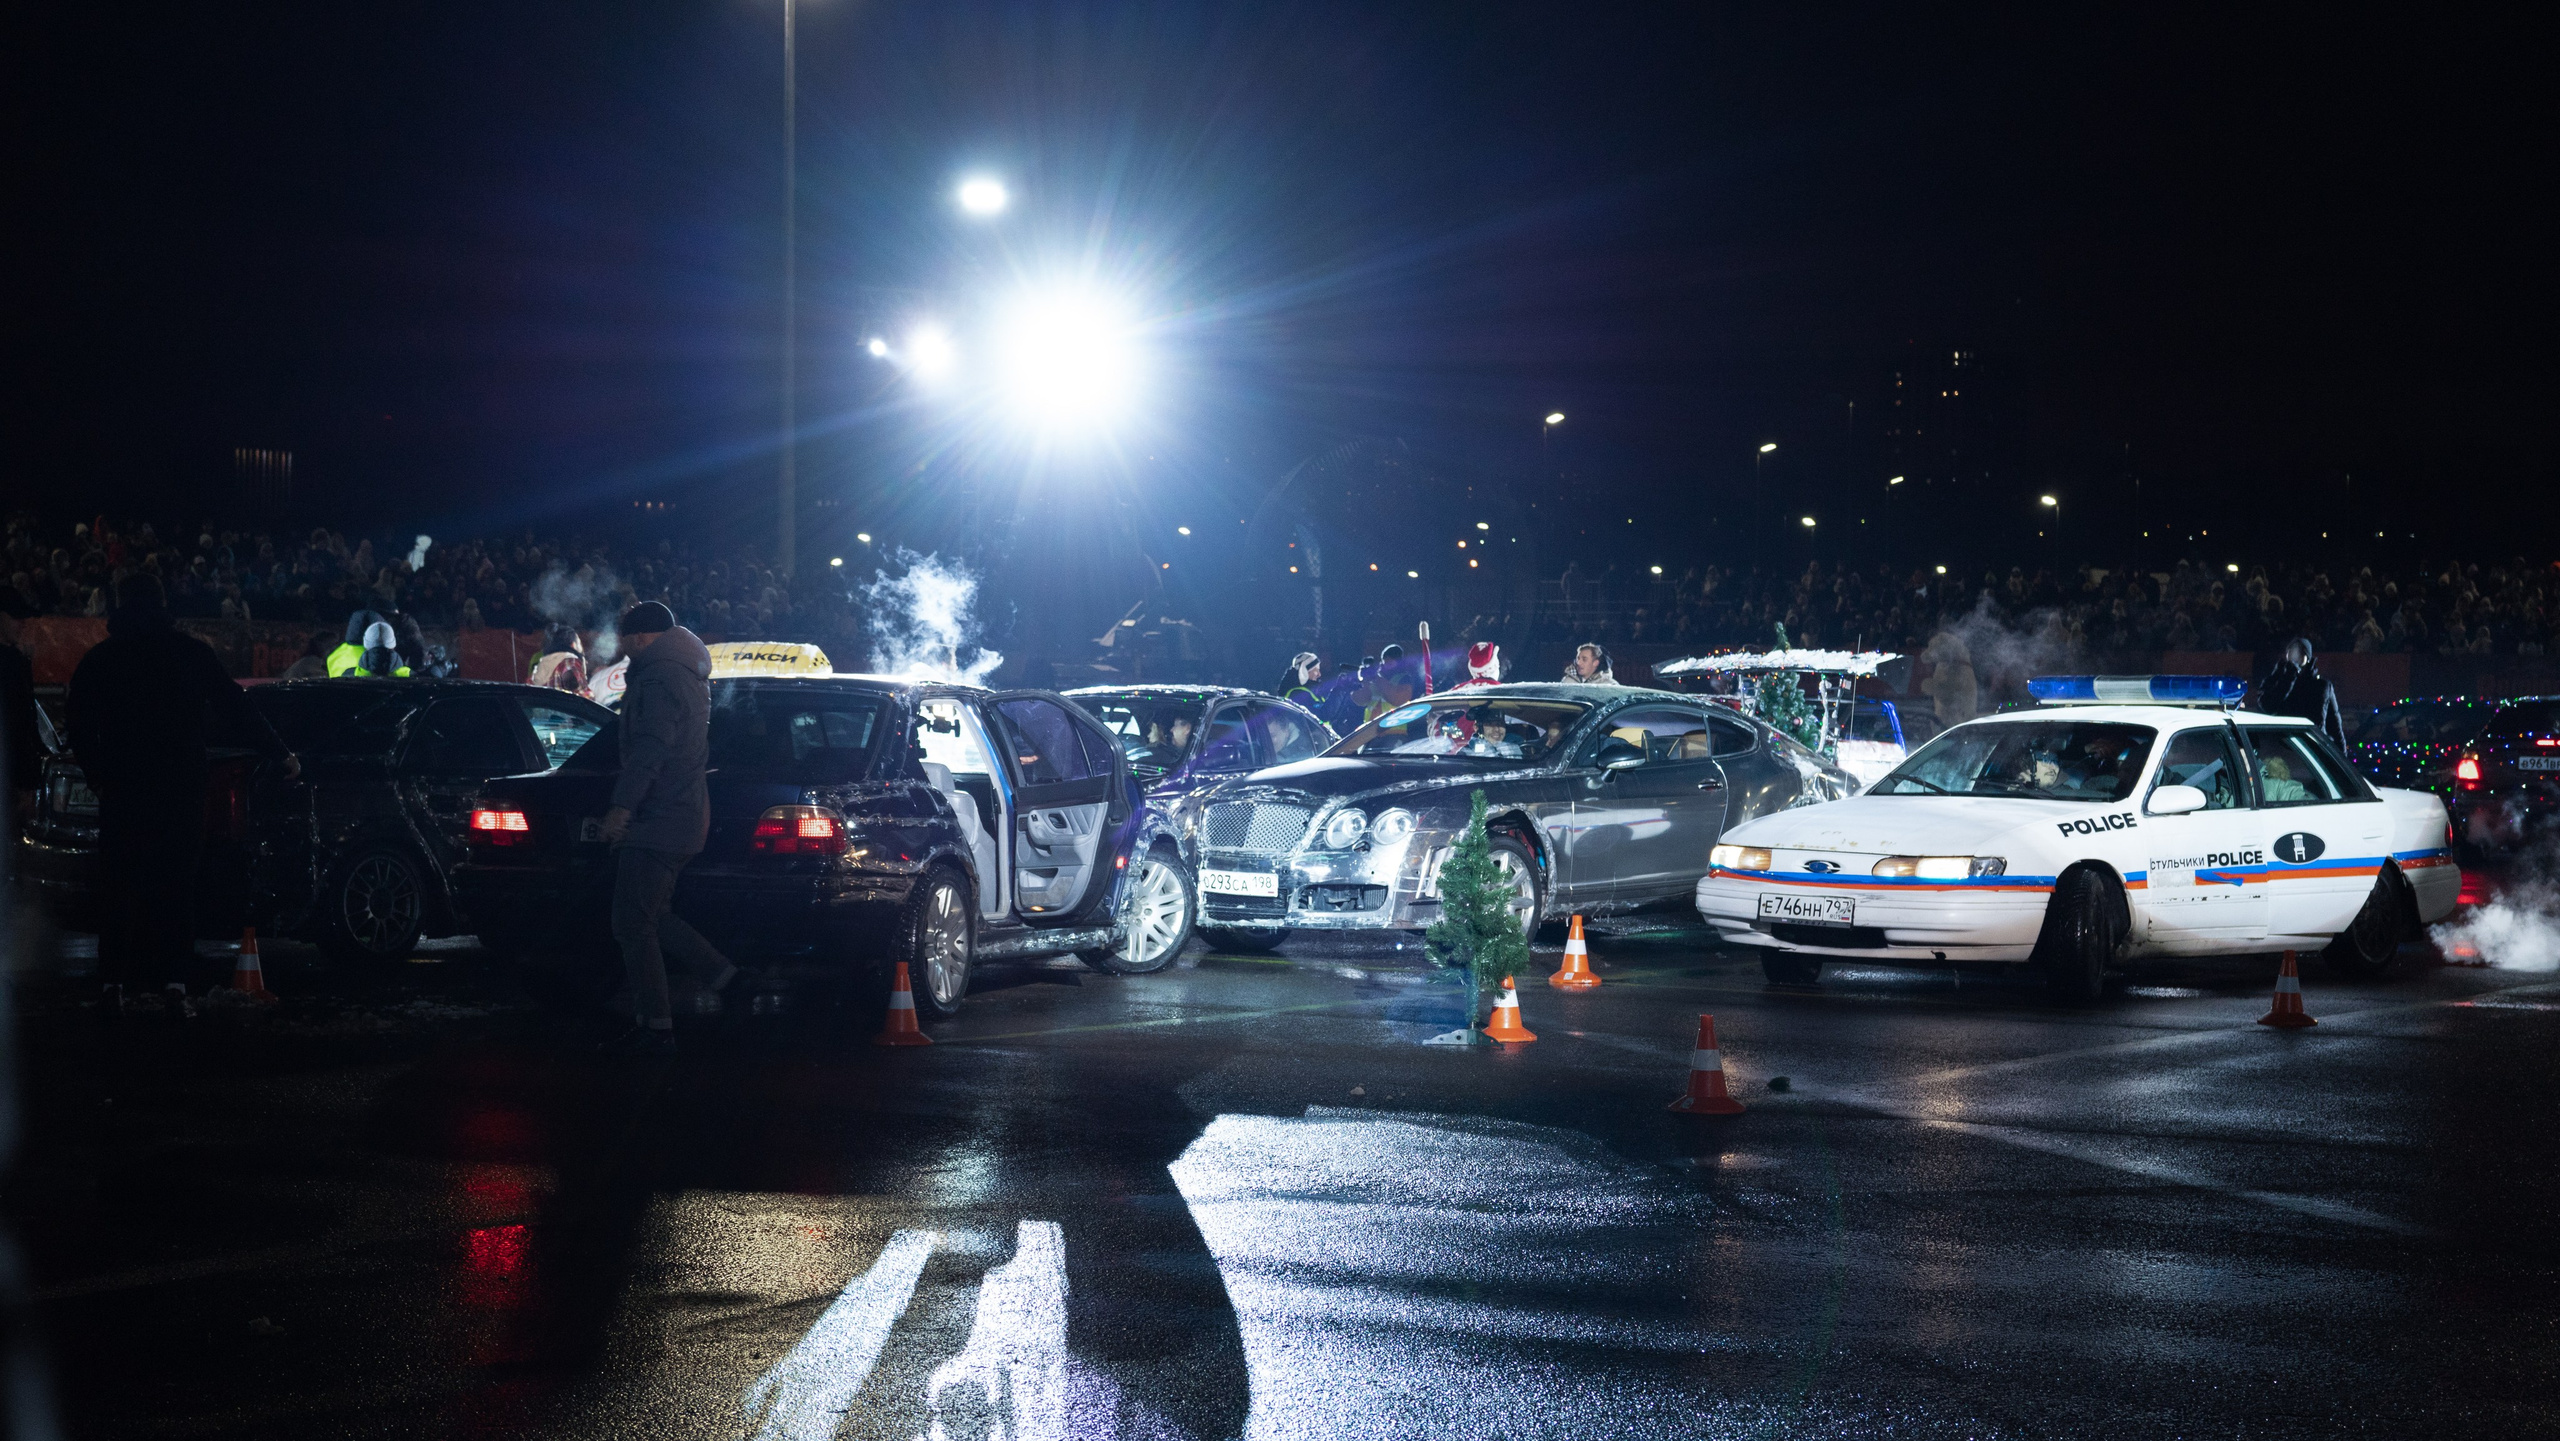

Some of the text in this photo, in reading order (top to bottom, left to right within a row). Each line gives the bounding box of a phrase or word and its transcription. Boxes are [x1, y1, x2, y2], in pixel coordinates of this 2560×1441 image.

[732, 652, 798, 663] ТАКСИ
[2057, 812, 2138, 837] POLICE
[2150, 850, 2263, 870] СТУЛЬЧИКИ POLICE
[1252, 876, 1272, 889] 198
[1764, 897, 1822, 917] Е746НН
